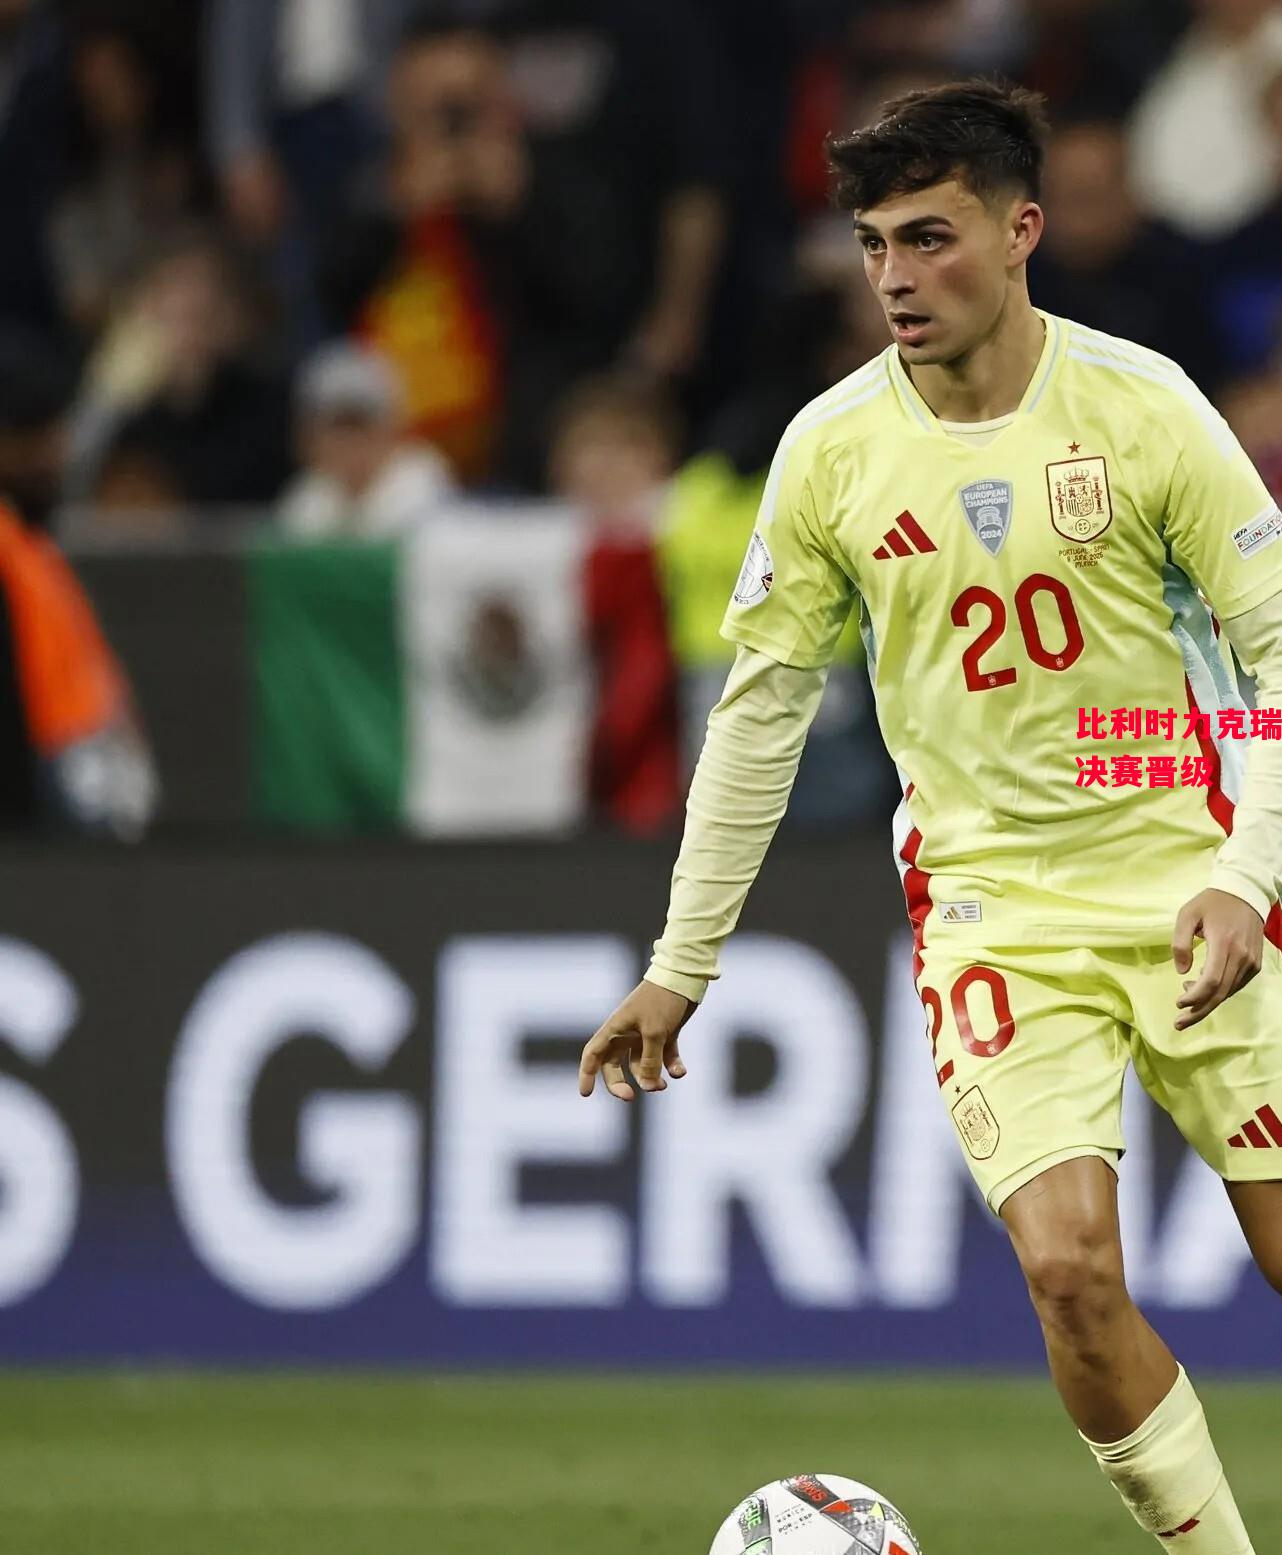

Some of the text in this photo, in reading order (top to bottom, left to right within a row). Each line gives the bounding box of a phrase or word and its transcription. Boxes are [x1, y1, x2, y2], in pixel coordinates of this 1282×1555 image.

[964, 488, 1007, 501] EUROPEAN
[965, 496, 1008, 509] CHAMPIONS
[981, 529, 1002, 539] 2024
[1233, 528, 1248, 541] UEFA
[1058, 548, 1088, 556] PORTUGAL
[951, 573, 1085, 692] 20
